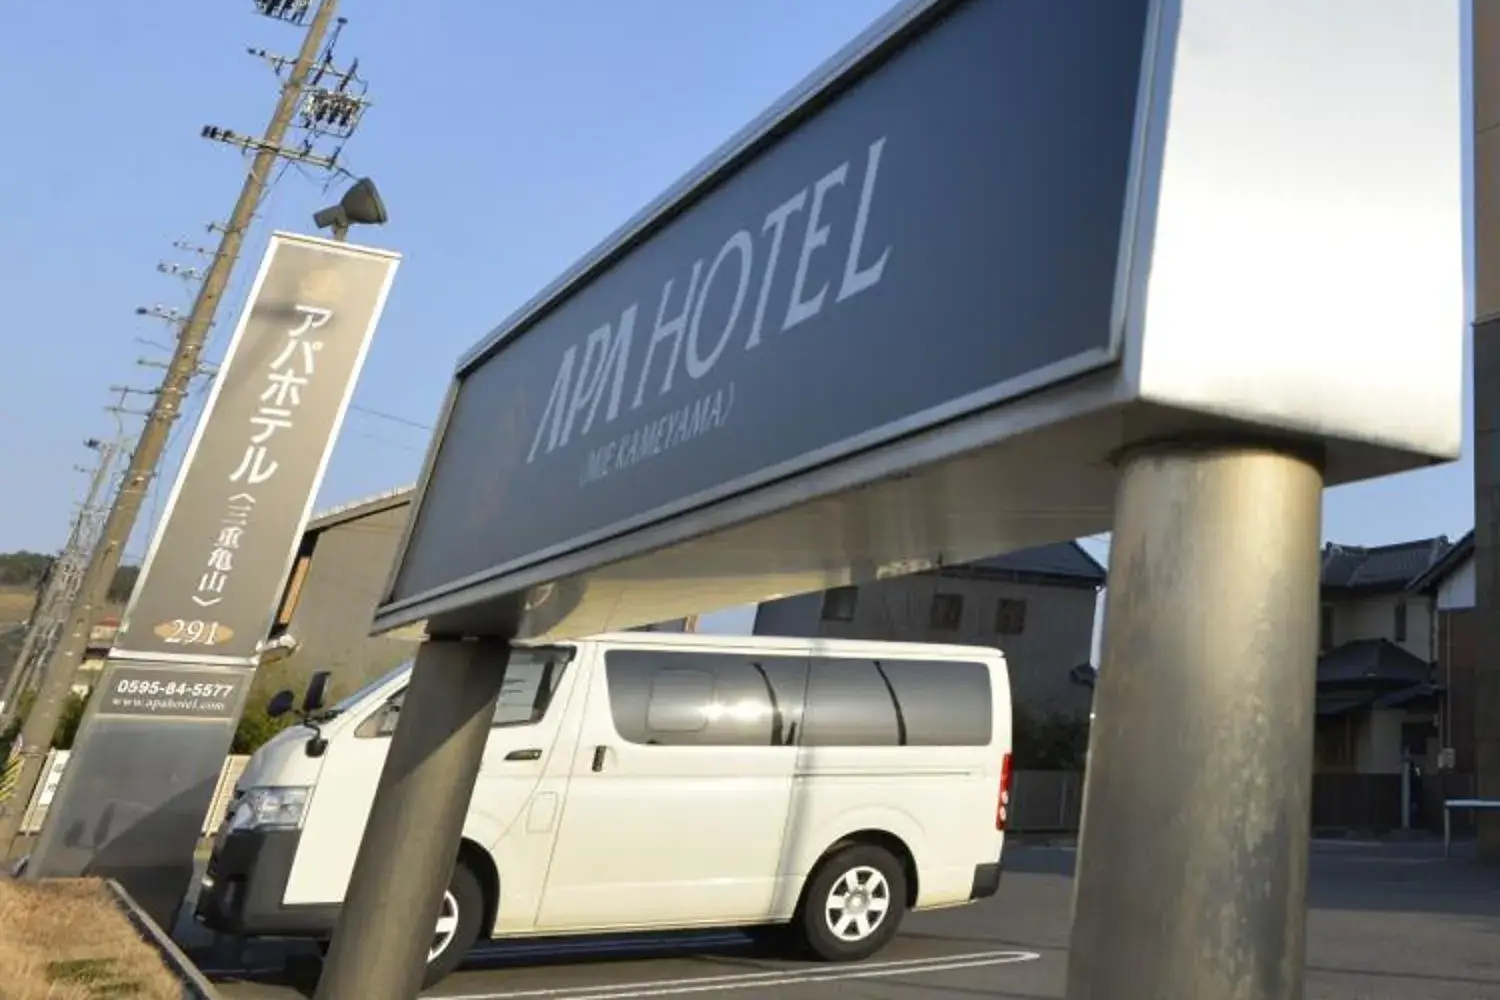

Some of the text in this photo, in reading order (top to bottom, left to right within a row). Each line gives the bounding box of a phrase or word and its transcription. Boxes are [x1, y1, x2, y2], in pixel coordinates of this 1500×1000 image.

[526, 135, 893, 464] APA HOTEL
[229, 304, 333, 484] アパホテル
[164, 618, 219, 646] 291
[117, 679, 233, 697] 0595-84-5577
